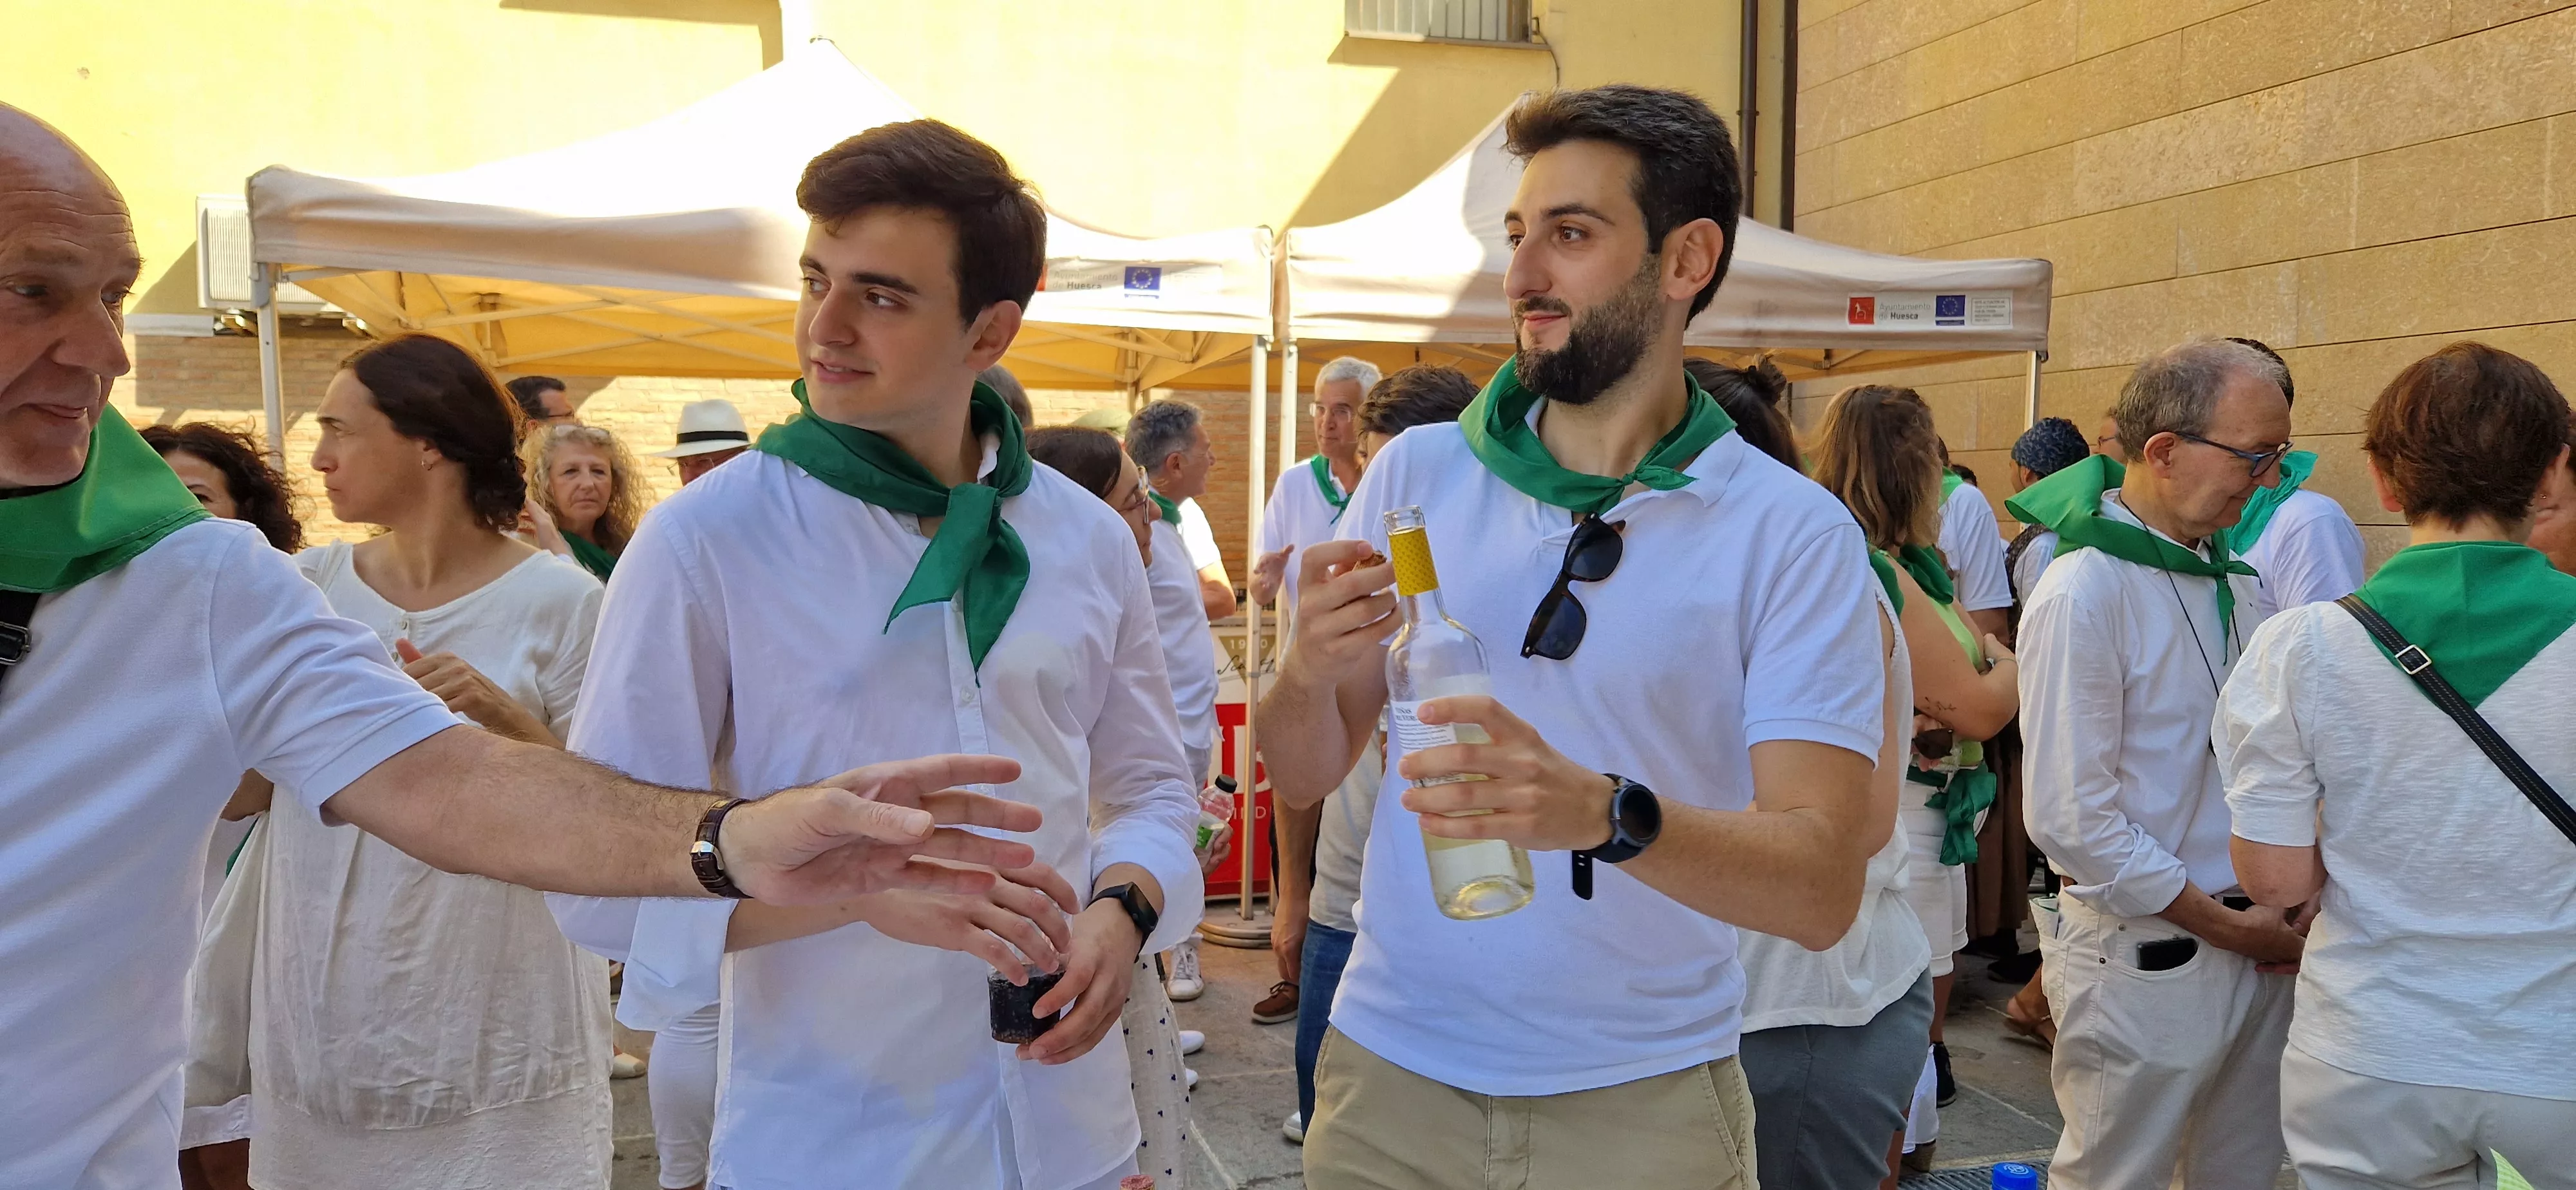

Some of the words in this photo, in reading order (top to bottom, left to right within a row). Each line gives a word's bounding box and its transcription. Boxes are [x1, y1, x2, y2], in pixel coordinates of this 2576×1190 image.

[1066, 281, 1102, 290] Huesca
[1879, 301, 1931, 312] Ayuntamiento
[1879, 312, 1888, 321] de
[1890, 312, 1918, 320] Huesca
[1230, 639, 1268, 650] 190
